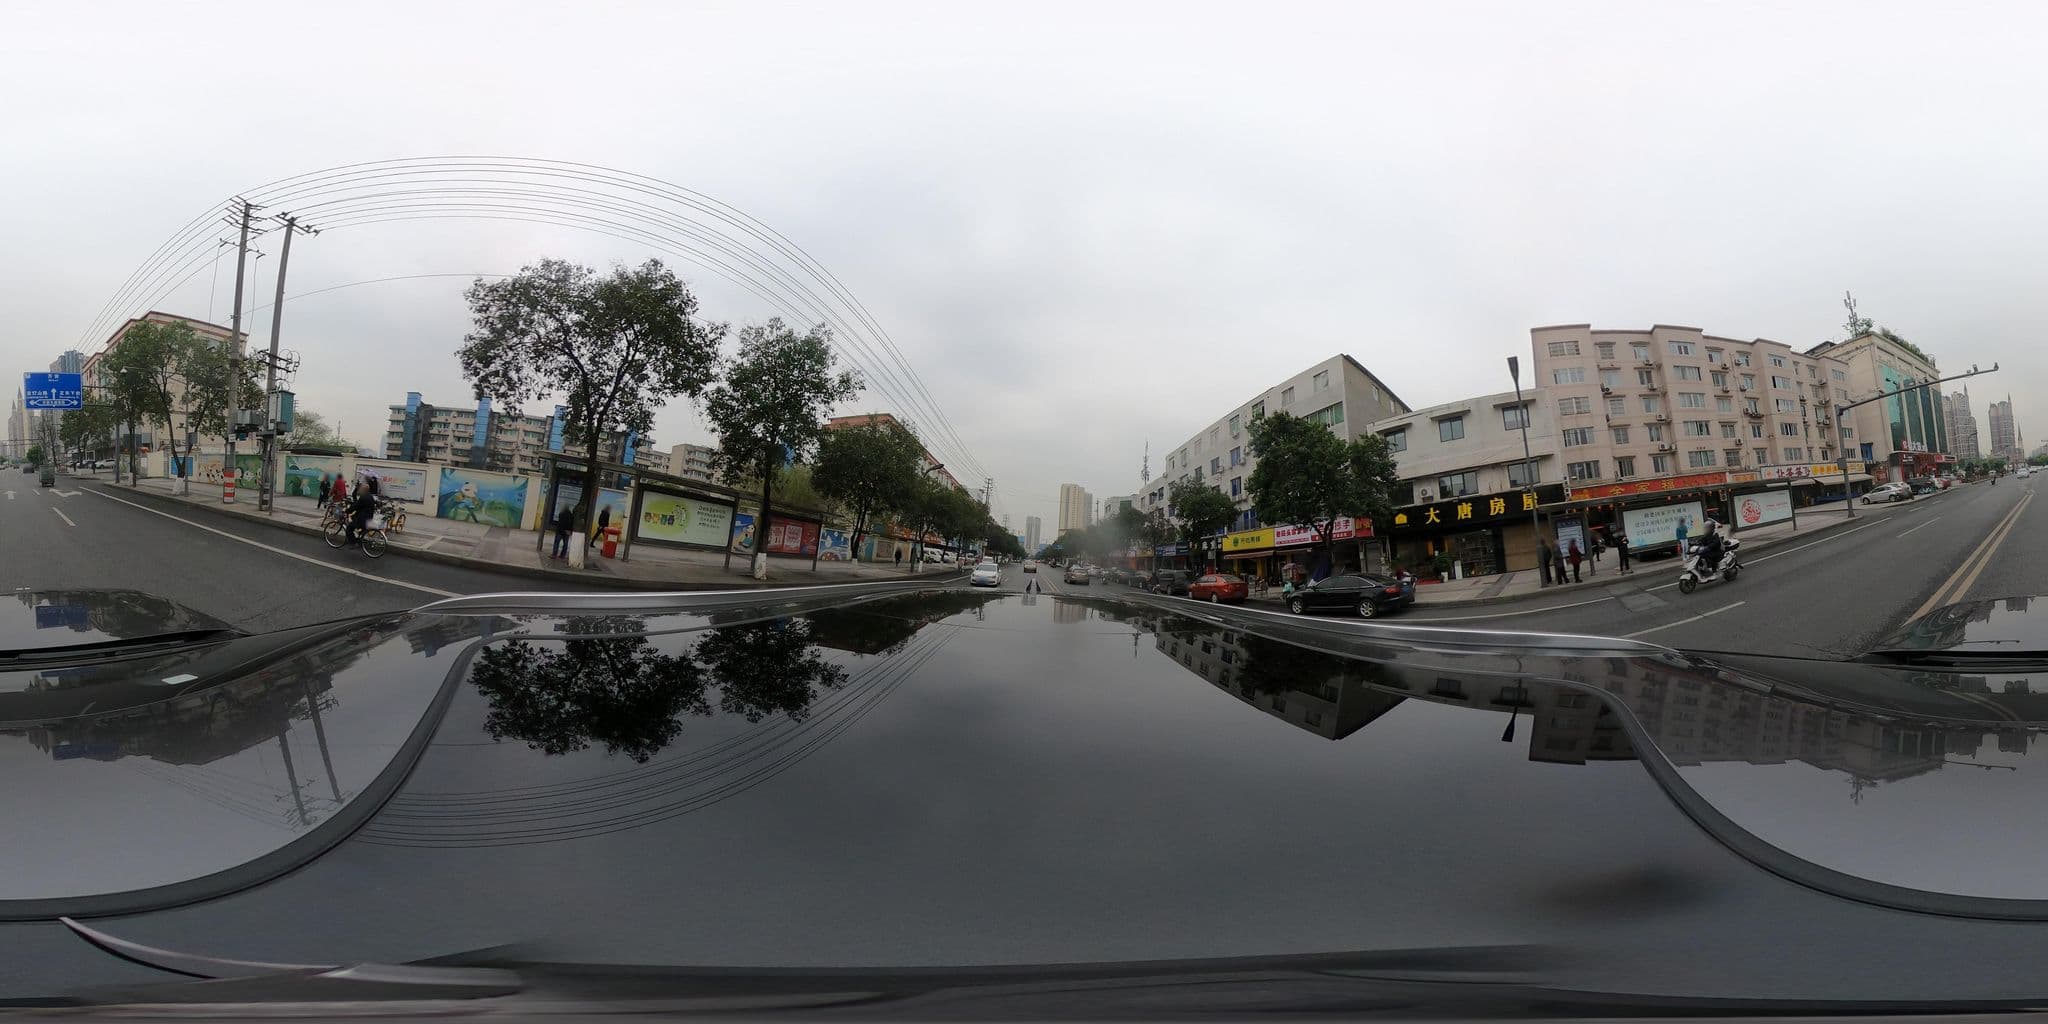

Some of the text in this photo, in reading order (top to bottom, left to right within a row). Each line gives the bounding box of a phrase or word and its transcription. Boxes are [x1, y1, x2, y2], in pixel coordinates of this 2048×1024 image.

[1608, 479, 1675, 496] 全家福
[1425, 492, 1538, 525] 大唐房屋
